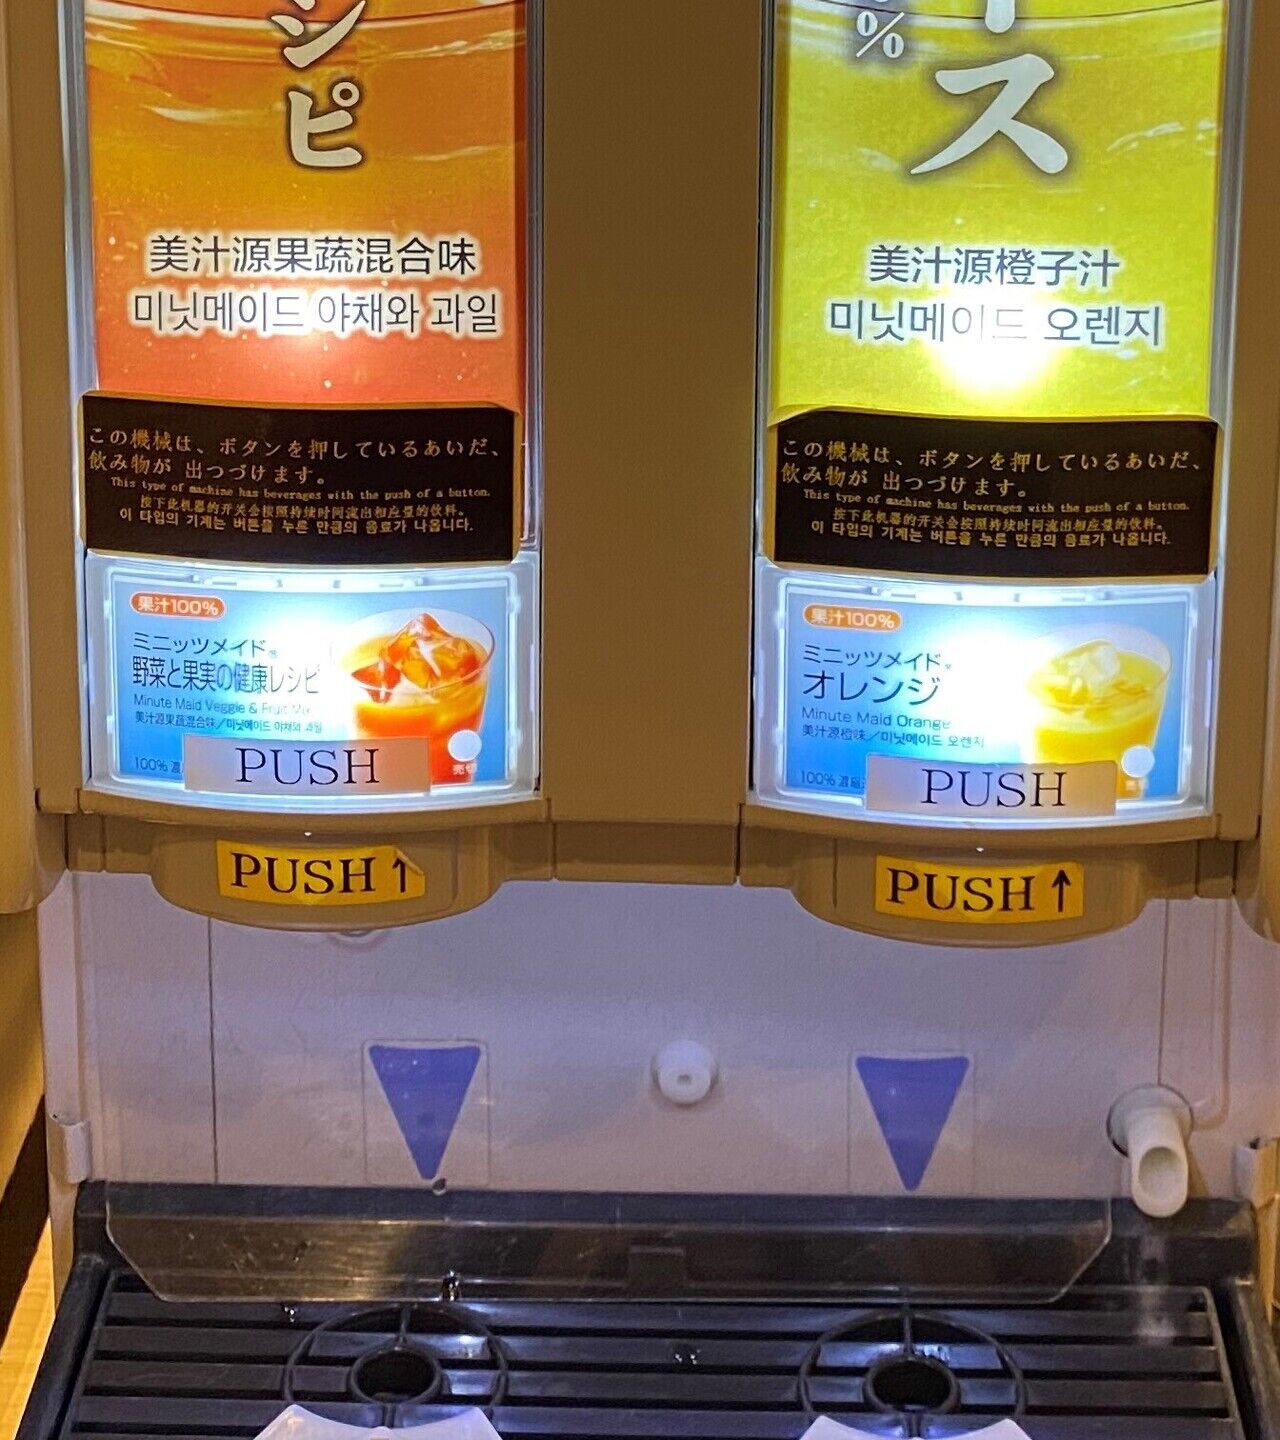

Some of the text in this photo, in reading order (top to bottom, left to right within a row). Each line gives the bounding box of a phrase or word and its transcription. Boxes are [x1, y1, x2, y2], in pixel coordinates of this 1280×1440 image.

[150, 235, 477, 275] 美汁源果蔬混合味
[870, 244, 1120, 287] 美汁源橙子汁
[134, 291, 498, 334] 미닛메이드 야채와 과일
[830, 300, 1161, 347] 미닛메이드 오렌지
[142, 479, 167, 492] type
[171, 482, 184, 493] of
[327, 489, 354, 500] with
[360, 489, 379, 500] the
[384, 489, 411, 501] push
[416, 488, 431, 499] of
[836, 491, 861, 504] type
[866, 494, 881, 504] of
[1028, 502, 1054, 513] with
[1060, 502, 1080, 513] the
[1085, 502, 1111, 514] push
[120, 507, 132, 522] 이
[811, 519, 825, 534] 이
[133, 693, 172, 709] Minute
[175, 696, 202, 711] Maid
[802, 670, 941, 706] オレンジ
[802, 706, 952, 730] Minute Maid Orange
[234, 747, 380, 786] PUSH
[920, 768, 1068, 808] PUSH
[230, 851, 377, 894] PUSH
[887, 867, 1035, 913] PUSH
